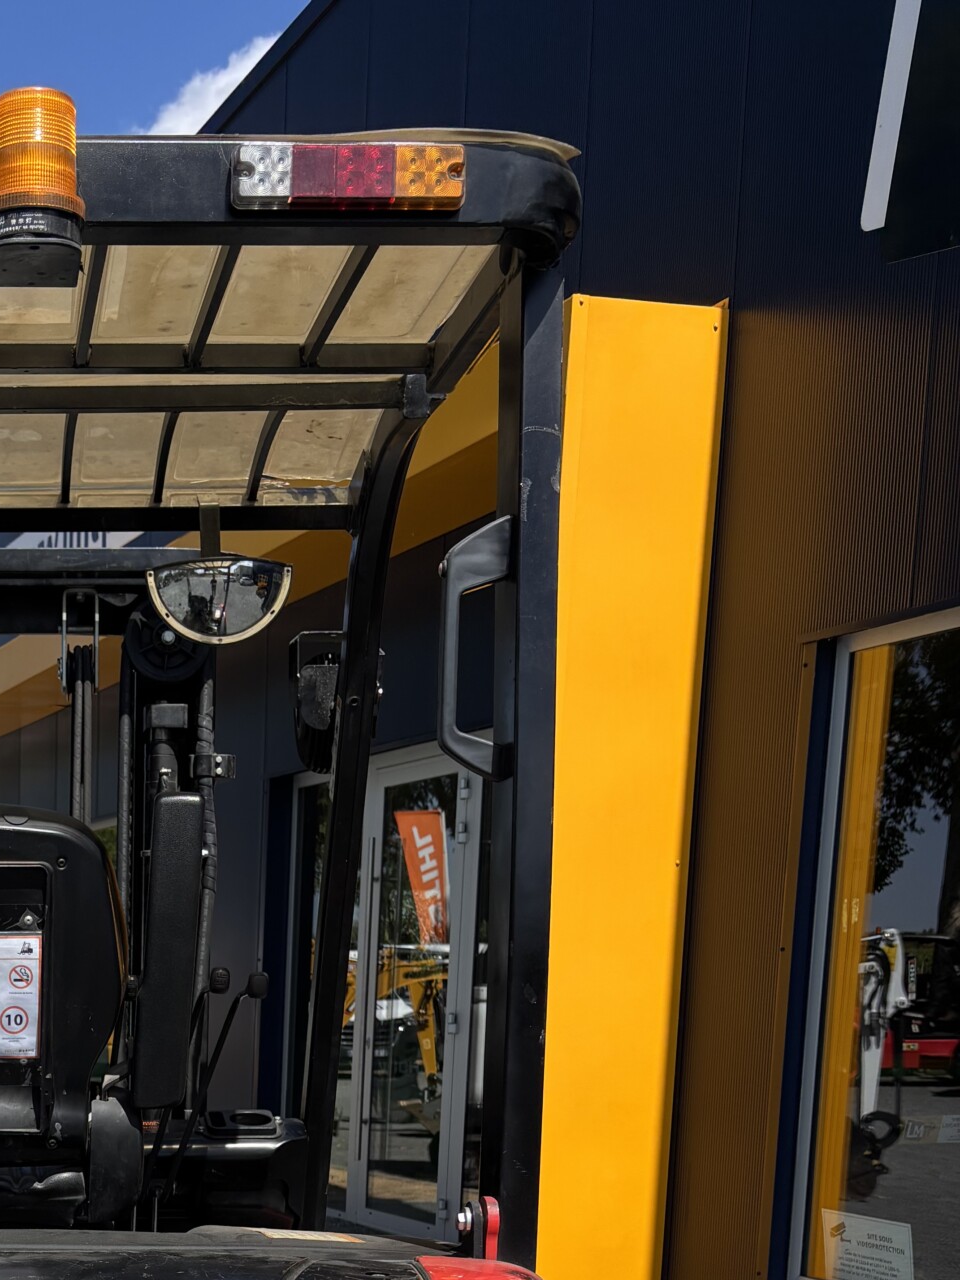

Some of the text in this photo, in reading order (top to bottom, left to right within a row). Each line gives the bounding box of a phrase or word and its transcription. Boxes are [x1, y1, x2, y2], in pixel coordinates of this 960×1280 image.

[5, 1014, 23, 1026] 10
[867, 1233, 893, 1244] SITE SOUS
